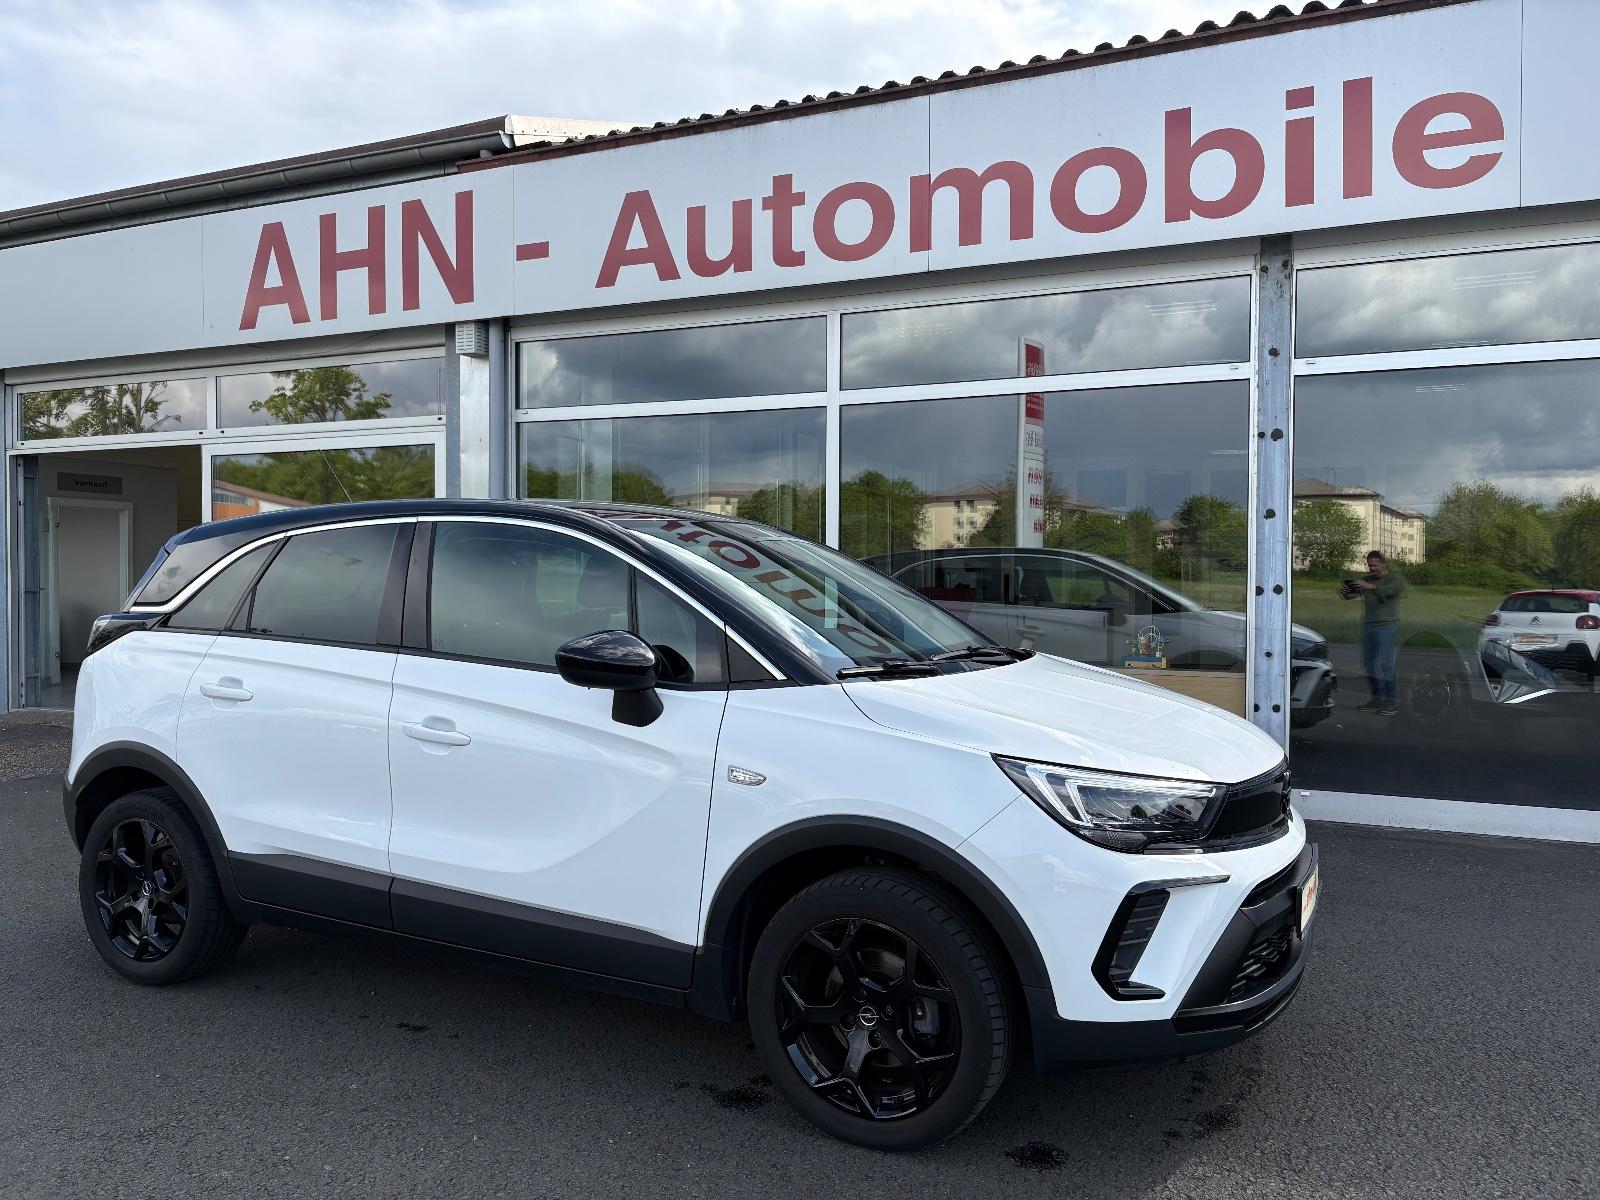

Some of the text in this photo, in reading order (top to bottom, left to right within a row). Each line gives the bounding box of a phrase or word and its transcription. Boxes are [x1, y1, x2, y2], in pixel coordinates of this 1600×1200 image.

[240, 78, 1504, 329] AHN - Automobile
